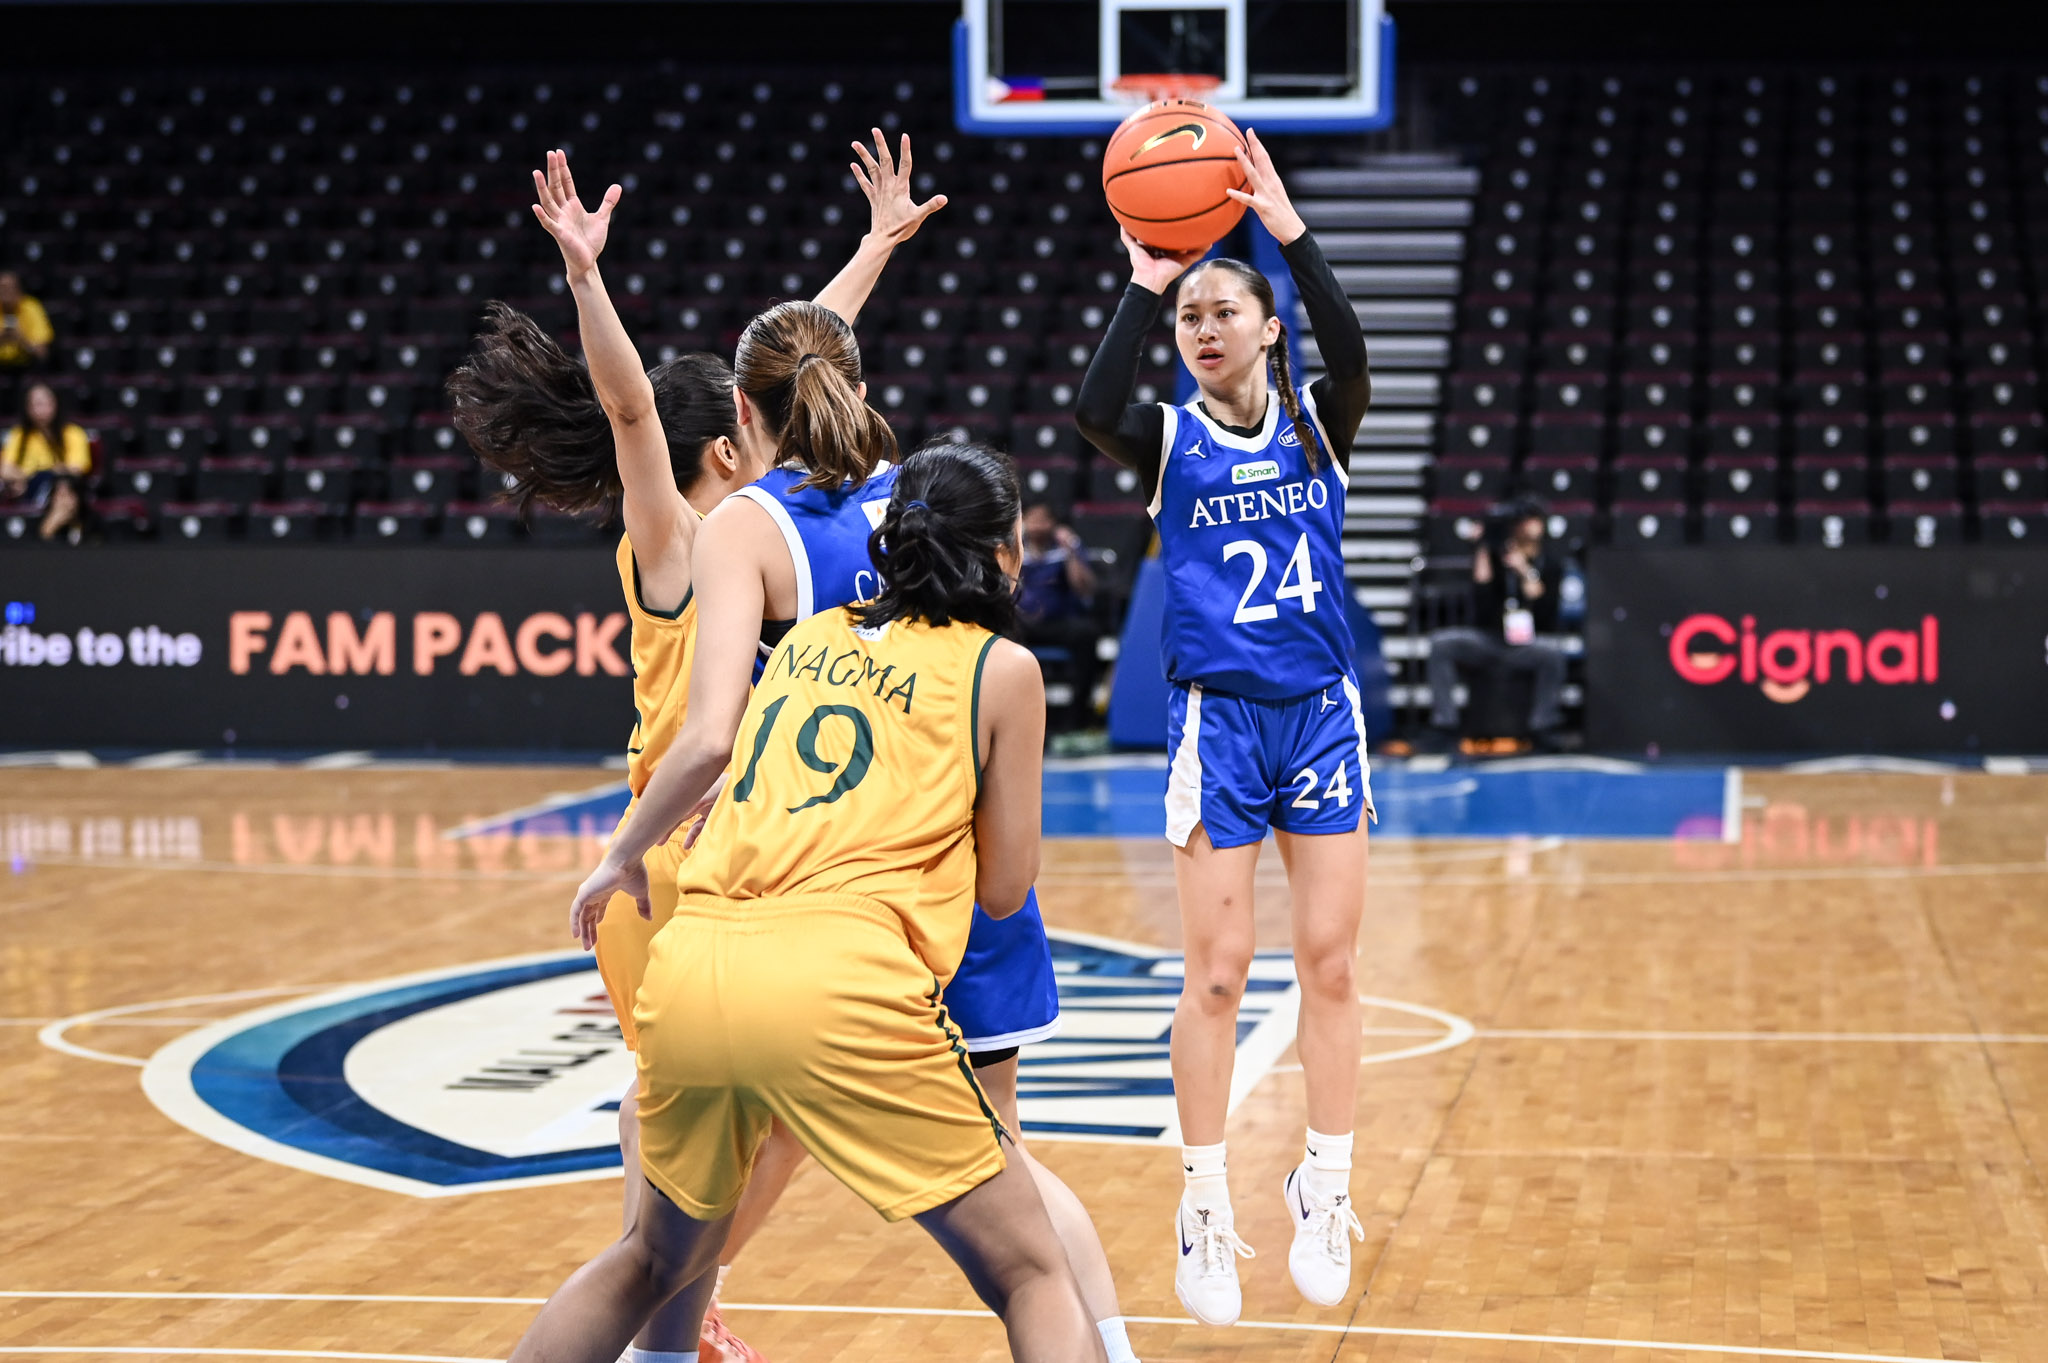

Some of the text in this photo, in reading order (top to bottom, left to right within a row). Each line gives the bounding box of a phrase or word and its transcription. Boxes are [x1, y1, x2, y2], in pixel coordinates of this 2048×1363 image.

[1189, 478, 1328, 528] ATENEO
[1247, 465, 1278, 478] Smart
[1222, 531, 1323, 624] 24
[76, 626, 125, 667] to
[127, 625, 203, 667] the
[229, 611, 397, 676] FAM
[412, 611, 630, 676] PACK
[1669, 613, 1940, 704] Cignal
[771, 643, 919, 715] NAGMA
[732, 694, 874, 815] 19
[1291, 759, 1353, 810] 24
